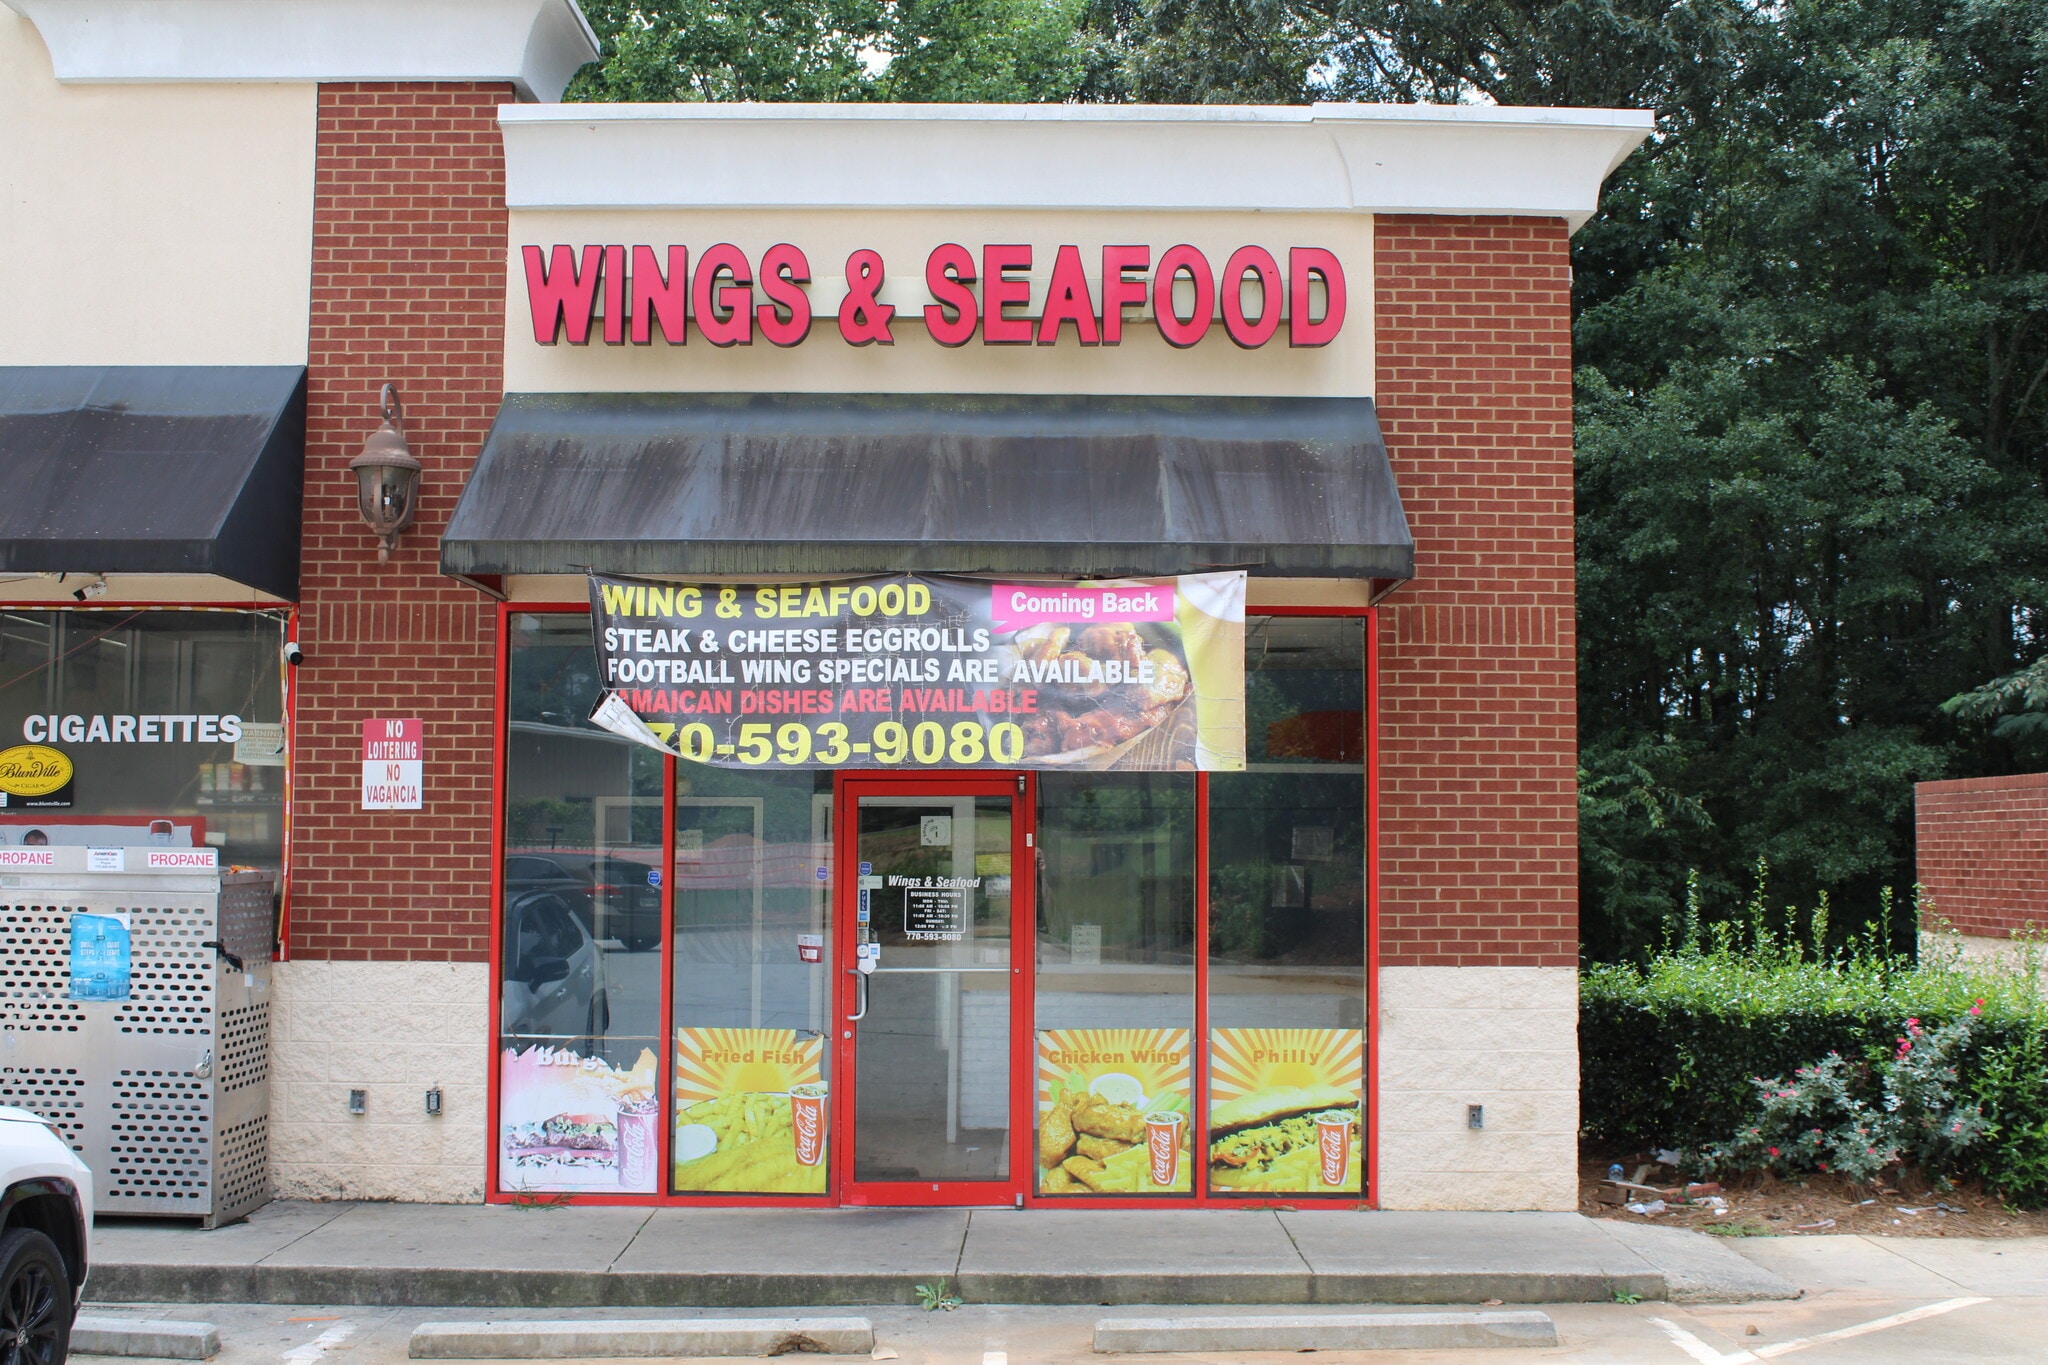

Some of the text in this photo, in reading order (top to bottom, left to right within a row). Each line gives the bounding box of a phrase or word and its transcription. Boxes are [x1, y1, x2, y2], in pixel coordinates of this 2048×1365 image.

[521, 242, 1347, 349] WINGS & SEAFOOD
[601, 583, 931, 619] WING & SEAFOOD
[1011, 591, 1158, 617] Coming Back
[604, 627, 990, 653] STEAK & CHEESE EGGROLLS
[607, 658, 1154, 684] FOOTBALL WING SPECIALS ARE AVAILABLE
[618, 688, 1038, 714] AMAICAN DISHES ARE AVAILABLE
[23, 714, 242, 743] CIGARETTES
[386, 720, 404, 738] NO
[367, 741, 417, 759] LOITERING
[645, 721, 1025, 764] 70-593-9080
[0, 760, 60, 778] BluntVille
[386, 764, 401, 781] NO
[366, 785, 417, 803] VAGANCIA
[0, 852, 53, 865] ROPANE
[150, 854, 214, 866] PROPANE
[888, 875, 921, 888] Wings
[924, 876, 932, 887] &
[936, 876, 981, 888] Seafood
[701, 1049, 805, 1064] Fried Fish
[1048, 1050, 1181, 1066] Chicken Wing
[1253, 1050, 1321, 1066] Philly
